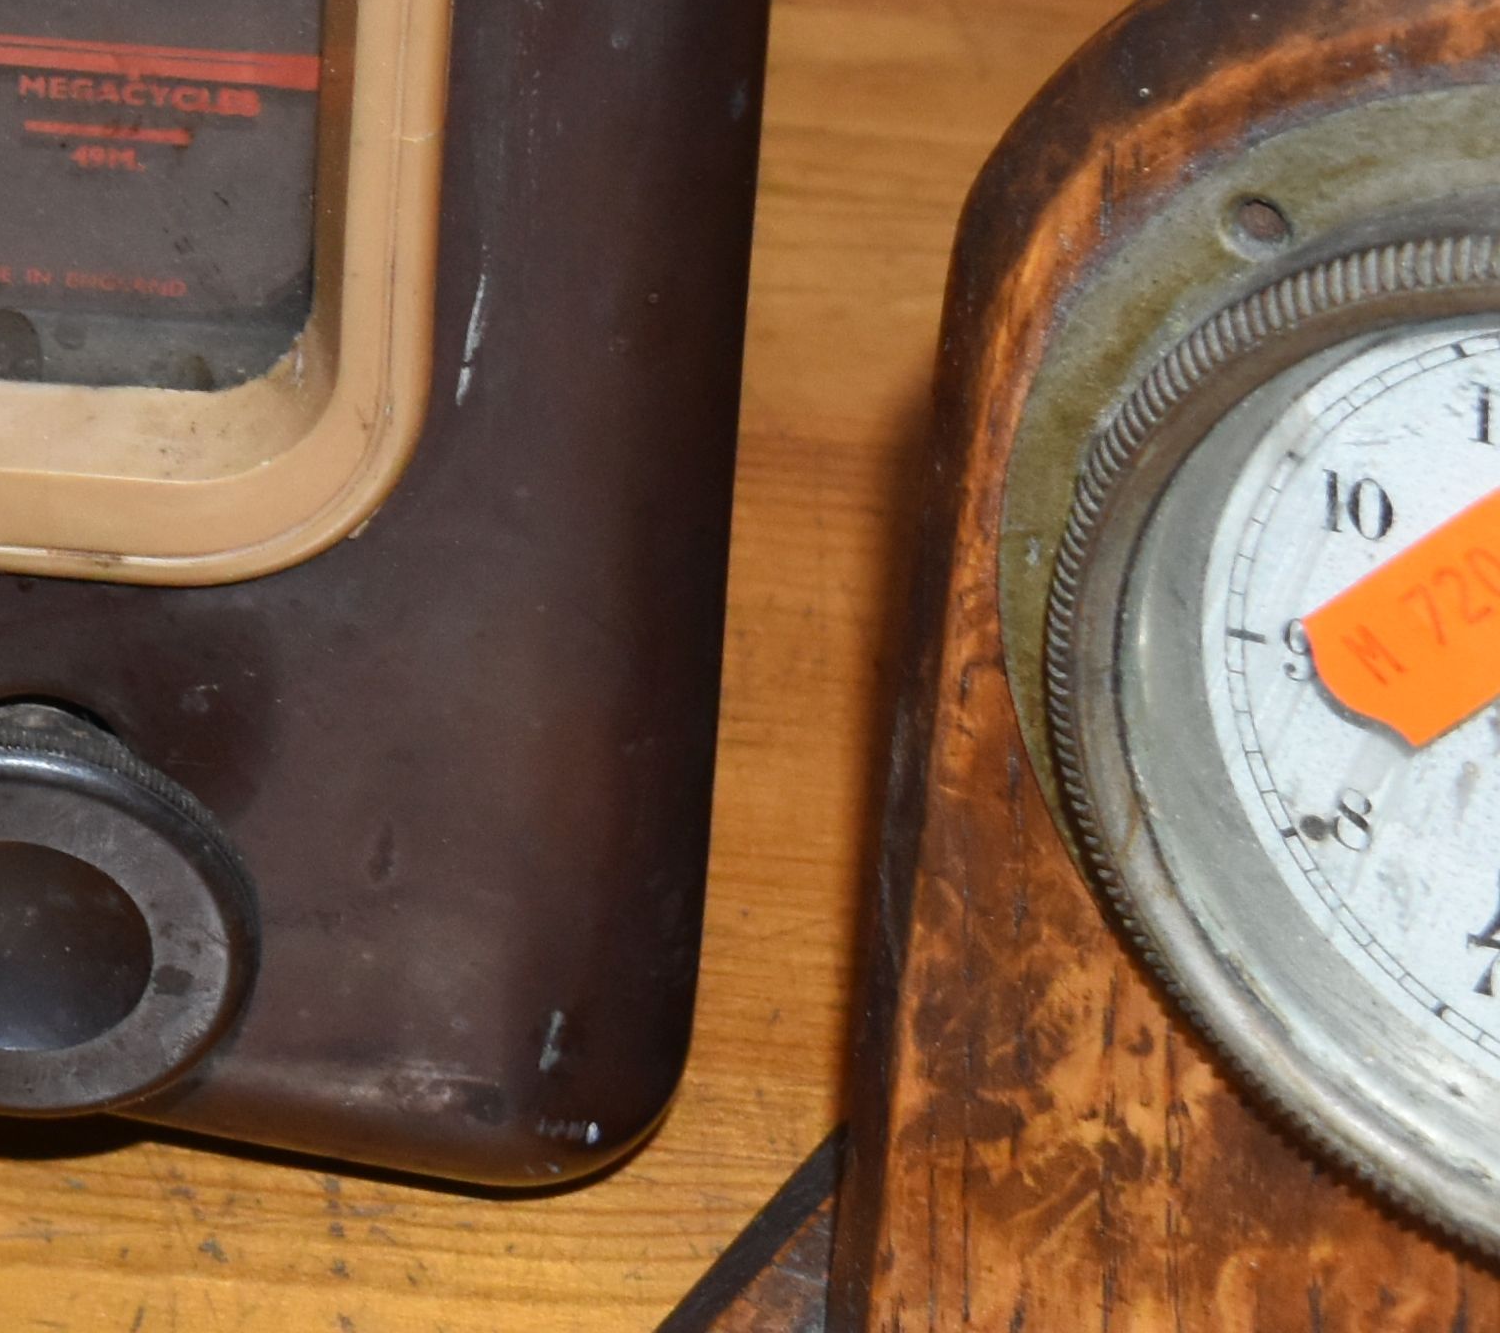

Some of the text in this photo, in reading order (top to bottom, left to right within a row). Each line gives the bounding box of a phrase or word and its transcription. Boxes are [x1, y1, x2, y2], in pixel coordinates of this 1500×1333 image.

[1321, 467, 1394, 542] 10
[1341, 547, 1500, 685] M 720
